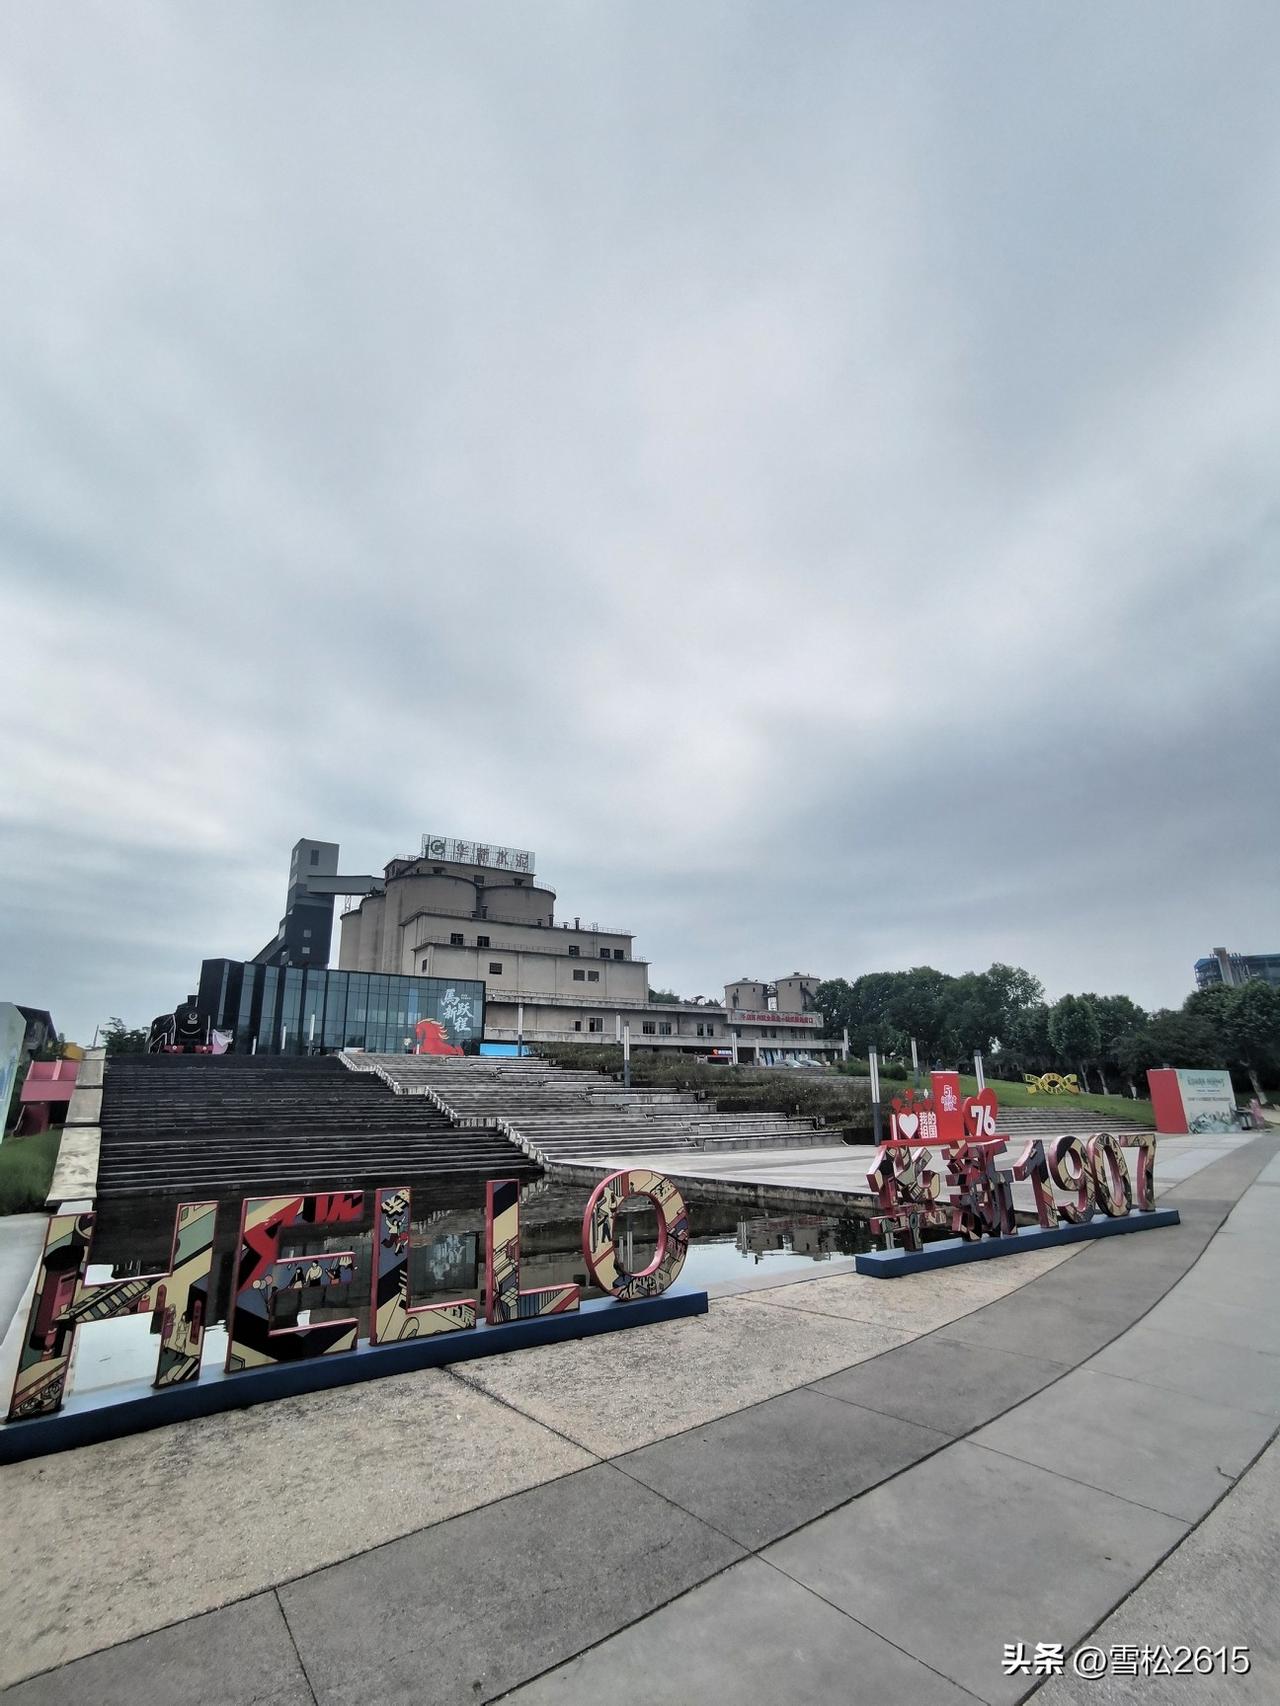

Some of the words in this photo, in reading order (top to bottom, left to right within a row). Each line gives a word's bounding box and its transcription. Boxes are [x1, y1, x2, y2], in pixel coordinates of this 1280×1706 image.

[455, 841, 529, 872] 华新水泥
[919, 1112, 937, 1125] 我的
[920, 1125, 938, 1139] 祖国
[970, 1105, 996, 1137] 76
[4, 1169, 689, 1422] HELLO
